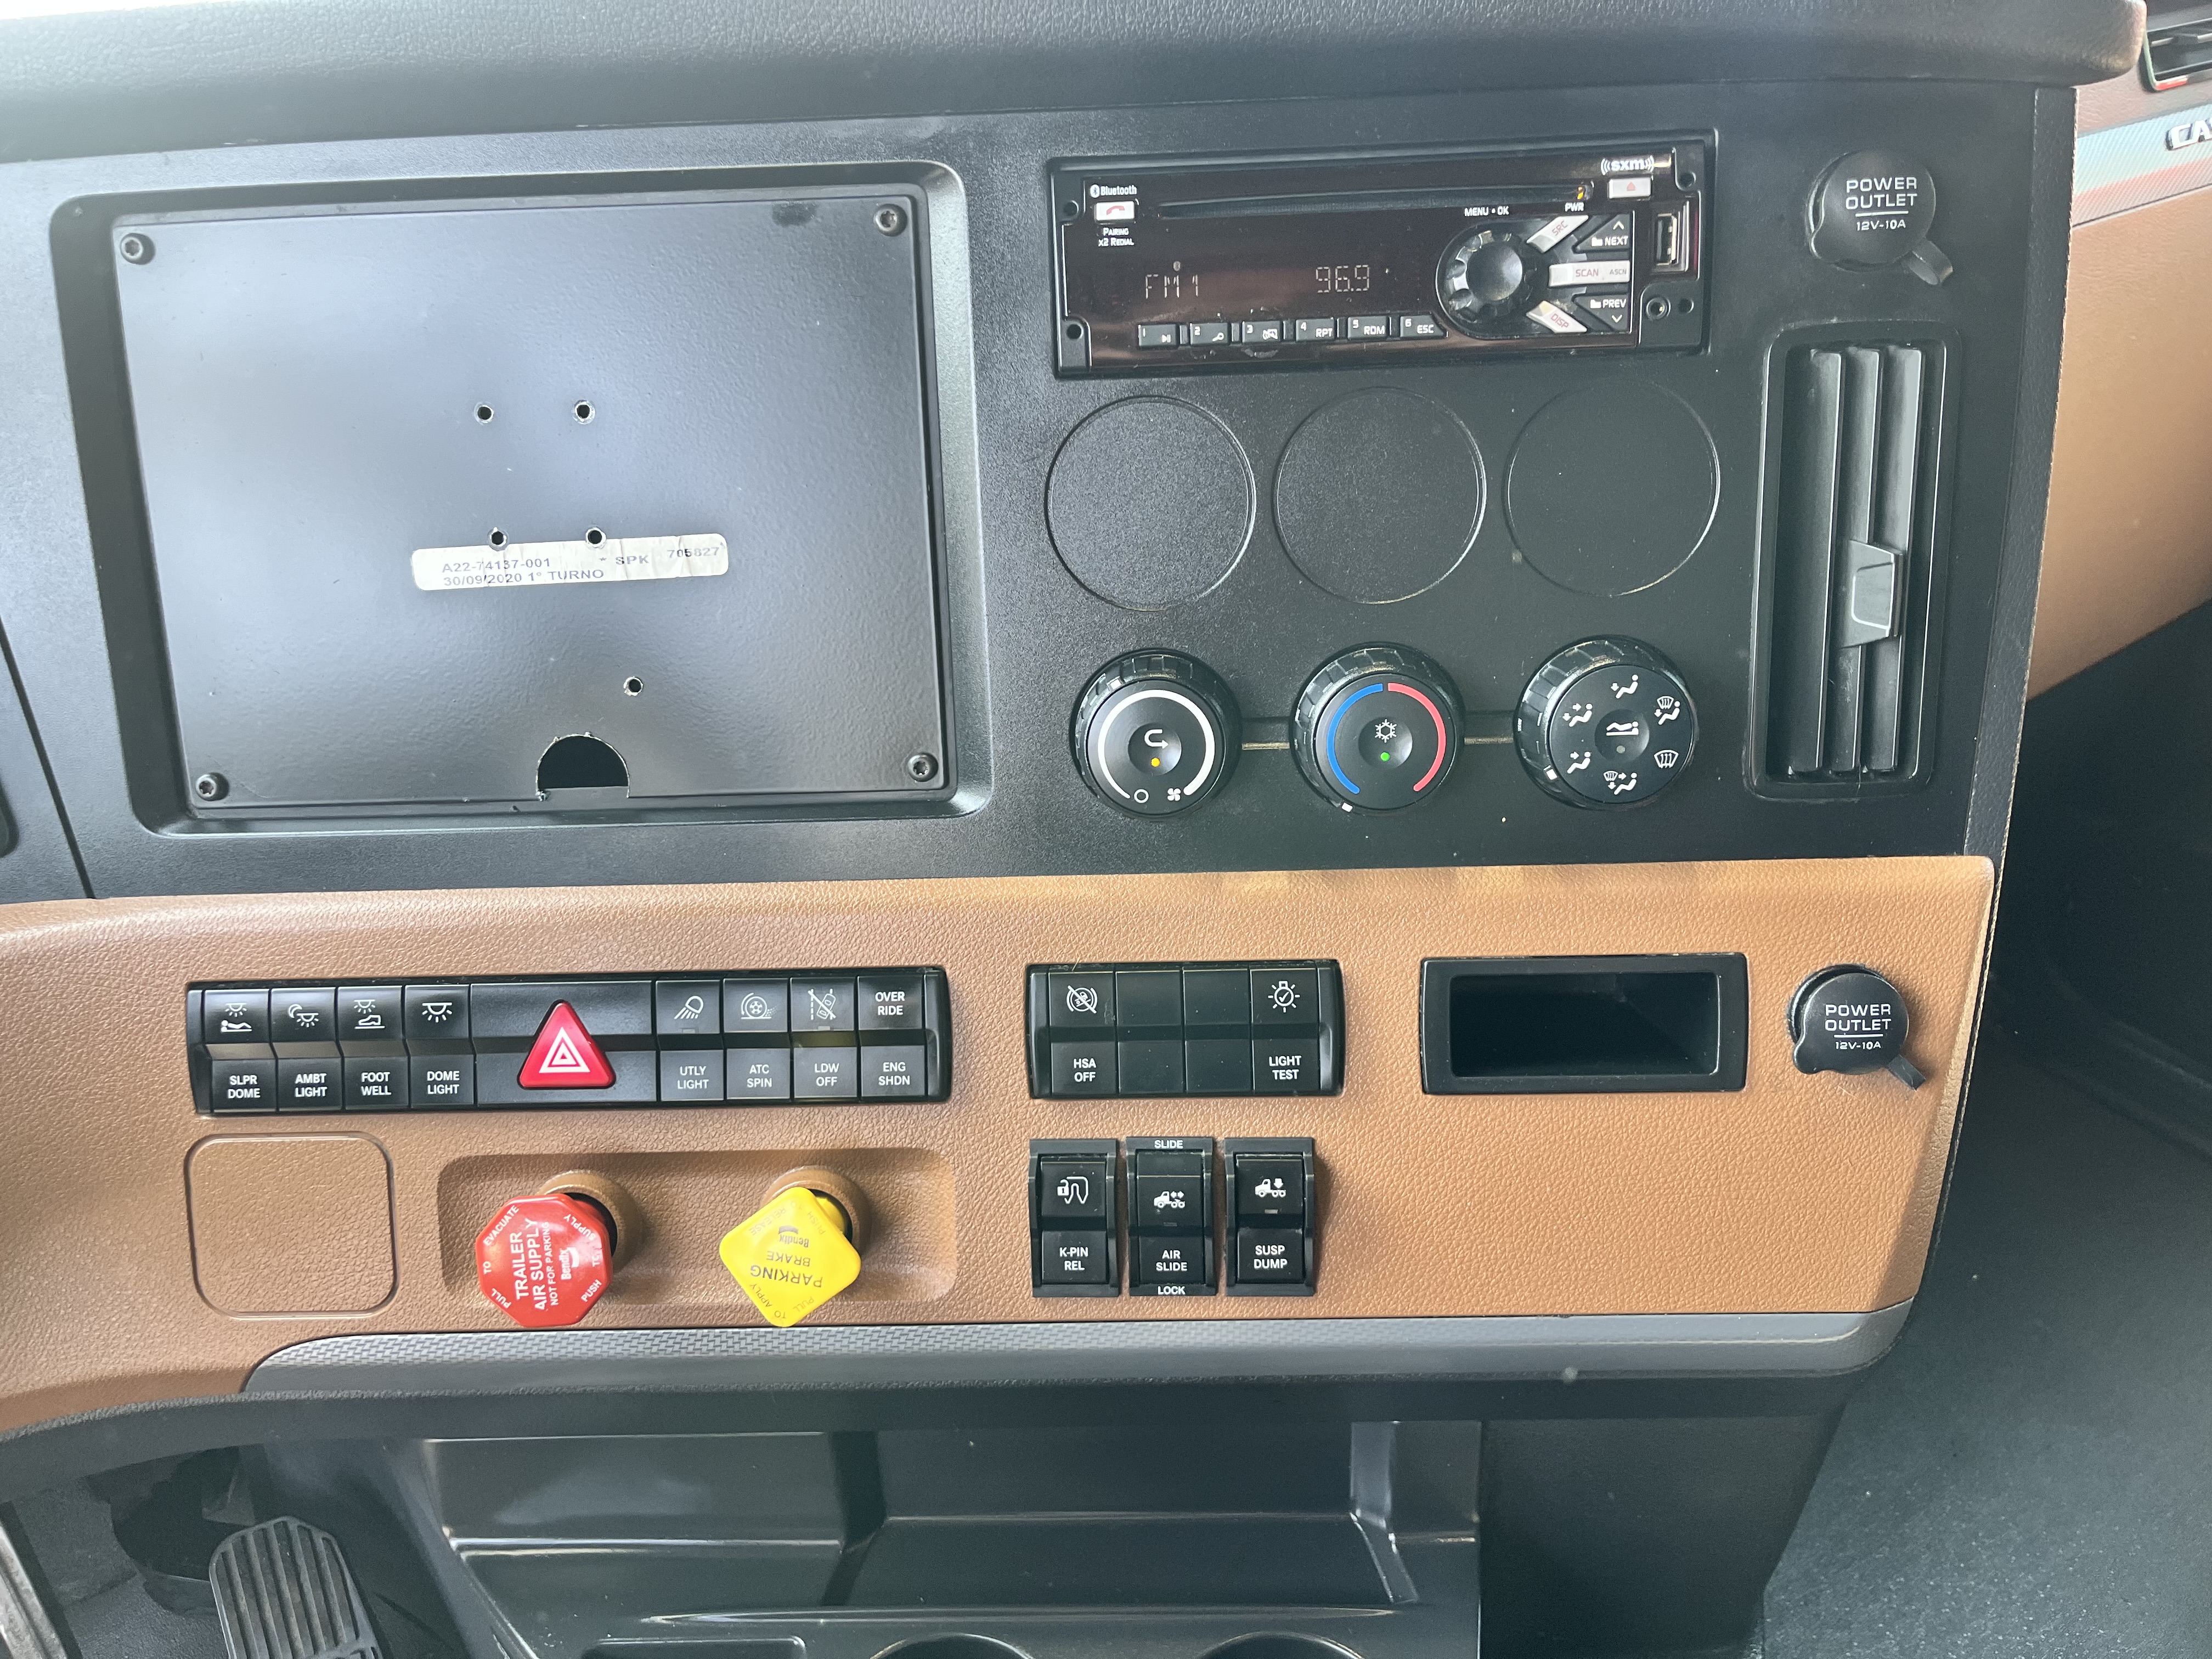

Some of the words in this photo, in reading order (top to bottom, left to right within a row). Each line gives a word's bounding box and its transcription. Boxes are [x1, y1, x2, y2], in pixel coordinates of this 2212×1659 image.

[2164, 116, 2212, 150] CA
[1101, 185, 1137, 196] Bluetooth
[1846, 177, 1917, 193] POWER
[1565, 202, 1584, 212] PWR
[1846, 194, 1917, 210] OUTLET
[1464, 207, 1489, 217] MENU
[1497, 206, 1509, 216] OK
[1551, 220, 1568, 236] SRC
[1856, 219, 1906, 232] 12V-10A
[1605, 236, 1628, 246] NEXT
[1575, 268, 1599, 277] SCAN
[1317, 264, 1370, 294] 96.9
[1602, 298, 1627, 308] PREV
[1300, 321, 1307, 331] 4
[1352, 319, 1359, 329] 5
[1405, 318, 1412, 328] 6
[1550, 313, 1569, 328] DISP
[1194, 326, 1200, 336] 2
[1246, 324, 1253, 334] 3
[1316, 328, 1333, 338] RPT
[1417, 324, 1434, 334] ESC
[667, 547, 720, 558] 705827
[442, 558, 551, 573] A22-74137-001
[616, 555, 650, 565] SPK
[444, 573, 522, 586] 30/09/2020
[548, 569, 604, 581] TURNO
[875, 991, 905, 1002] OVER
[877, 1005, 904, 1016] RIDE
[1825, 1004, 1891, 1016] POWER
[1825, 1018, 1892, 1031] OUTLET
[1835, 1041, 1881, 1050] 12V-10A
[1073, 1058, 1097, 1069] HSA
[1269, 1055, 1302, 1066] LIGHT
[679, 1065, 707, 1076] UTLY
[749, 1064, 770, 1075] ATC
[814, 1063, 840, 1073] LDW
[883, 1062, 906, 1073] ENG
[295, 1073, 326, 1084] AMBT
[361, 1071, 391, 1082] FOOT
[427, 1070, 460, 1081] DOME
[1074, 1071, 1096, 1082] OFF
[1272, 1069, 1300, 1080] TEST
[229, 1075, 258, 1086] SLPR
[677, 1079, 709, 1090] LIGHT
[747, 1077, 772, 1088] SPIN
[816, 1076, 838, 1087] OFF
[878, 1075, 911, 1086] SHDN
[228, 1087, 261, 1099] DOME
[295, 1086, 328, 1098] LIGHT
[361, 1085, 392, 1096] WELL
[427, 1084, 460, 1095] LIGHT
[1154, 1139, 1184, 1149] SLIDE
[482, 1205, 520, 1247] EVACUATE
[748, 1206, 787, 1236] RELEASE
[806, 1211, 826, 1235] PUSH
[563, 1214, 596, 1241] SUPPLY
[542, 1222, 553, 1266] PARKING
[779, 1234, 809, 1248] Bendix
[524, 1217, 544, 1281] SUPPLY
[1059, 1246, 1088, 1257] K-PIN
[1255, 1245, 1285, 1256] SUSP
[766, 1250, 811, 1267] BRAKE
[1162, 1250, 1181, 1260] AIR
[482, 1261, 492, 1275] TO
[509, 1232, 529, 1300] TRAILER
[559, 1247, 572, 1280] Bendix
[1064, 1260, 1085, 1271] REL
[1155, 1262, 1188, 1272] SLIDE
[1254, 1259, 1288, 1269] DUMP
[546, 1266, 556, 1286] FOR
[750, 1264, 823, 1288] PARKING
[548, 1286, 559, 1306] NOT
[580, 1279, 602, 1302] PUSH
[749, 1283, 773, 1308] APPLY
[1157, 1285, 1186, 1296] LOCK
[491, 1288, 512, 1309] PULL
[532, 1284, 546, 1310] AIR
[792, 1296, 815, 1313] PULL
[774, 1310, 787, 1319] TO
